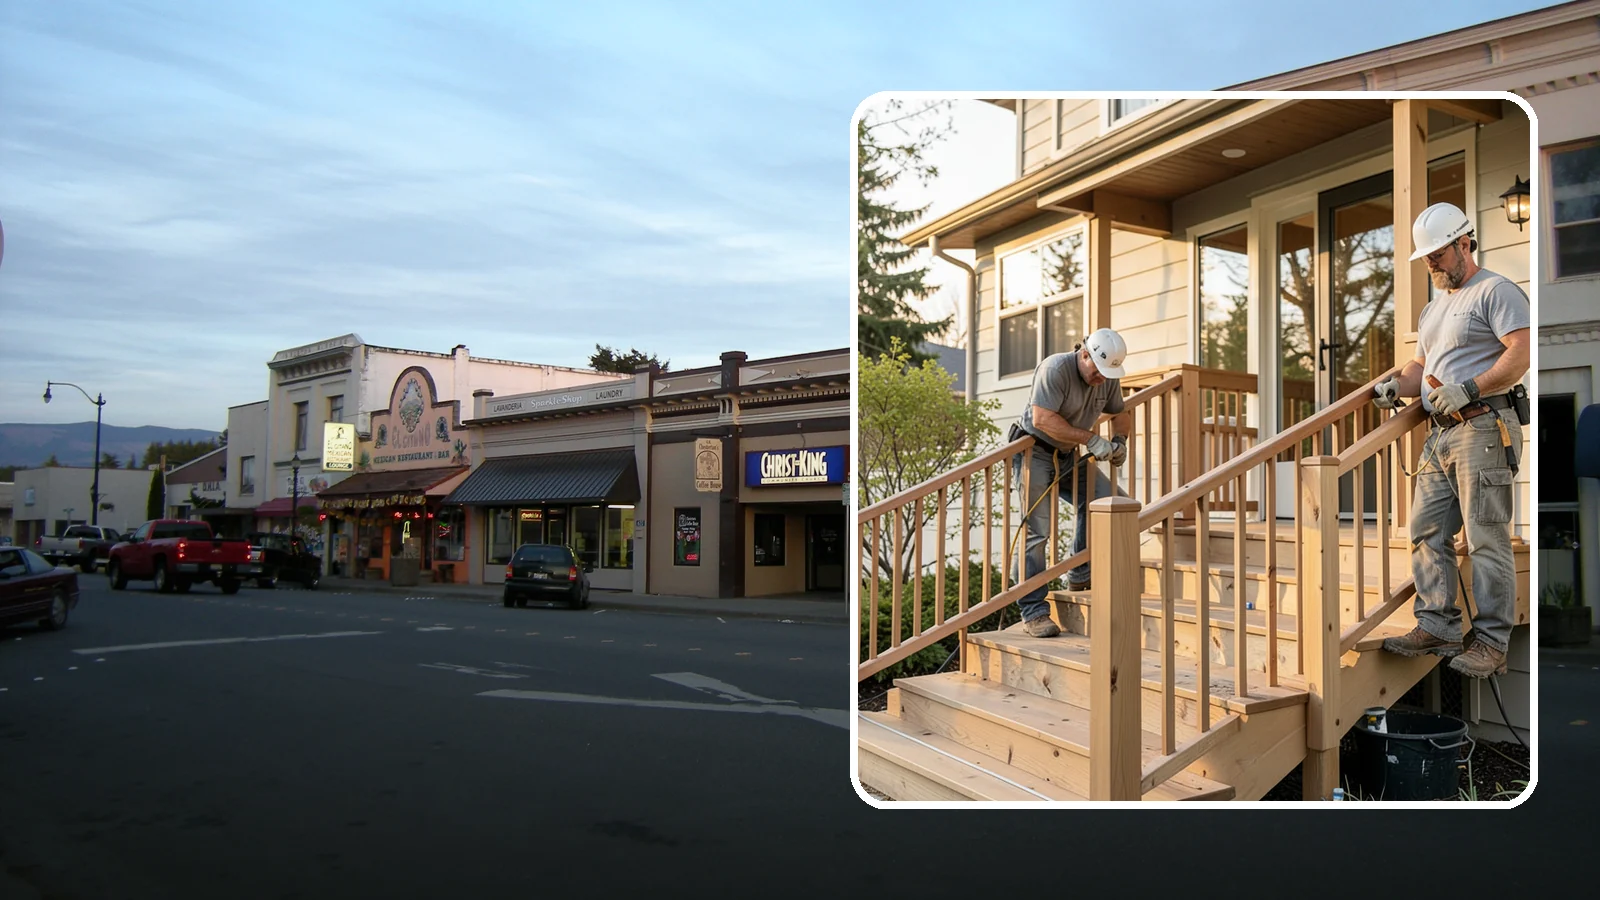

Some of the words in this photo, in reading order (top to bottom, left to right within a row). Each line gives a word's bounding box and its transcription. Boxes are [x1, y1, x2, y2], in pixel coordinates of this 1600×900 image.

[530, 397, 560, 409] Sparkle
[562, 394, 582, 405] Shop
[595, 389, 623, 400] LAUNDRY
[493, 401, 523, 413] LAVANDERIA
[373, 454, 396, 464] MEXICAN
[397, 451, 433, 463] RESTAURANT
[437, 450, 450, 459] BAR
[761, 452, 797, 477] CHRIST
[799, 450, 827, 476] KING
